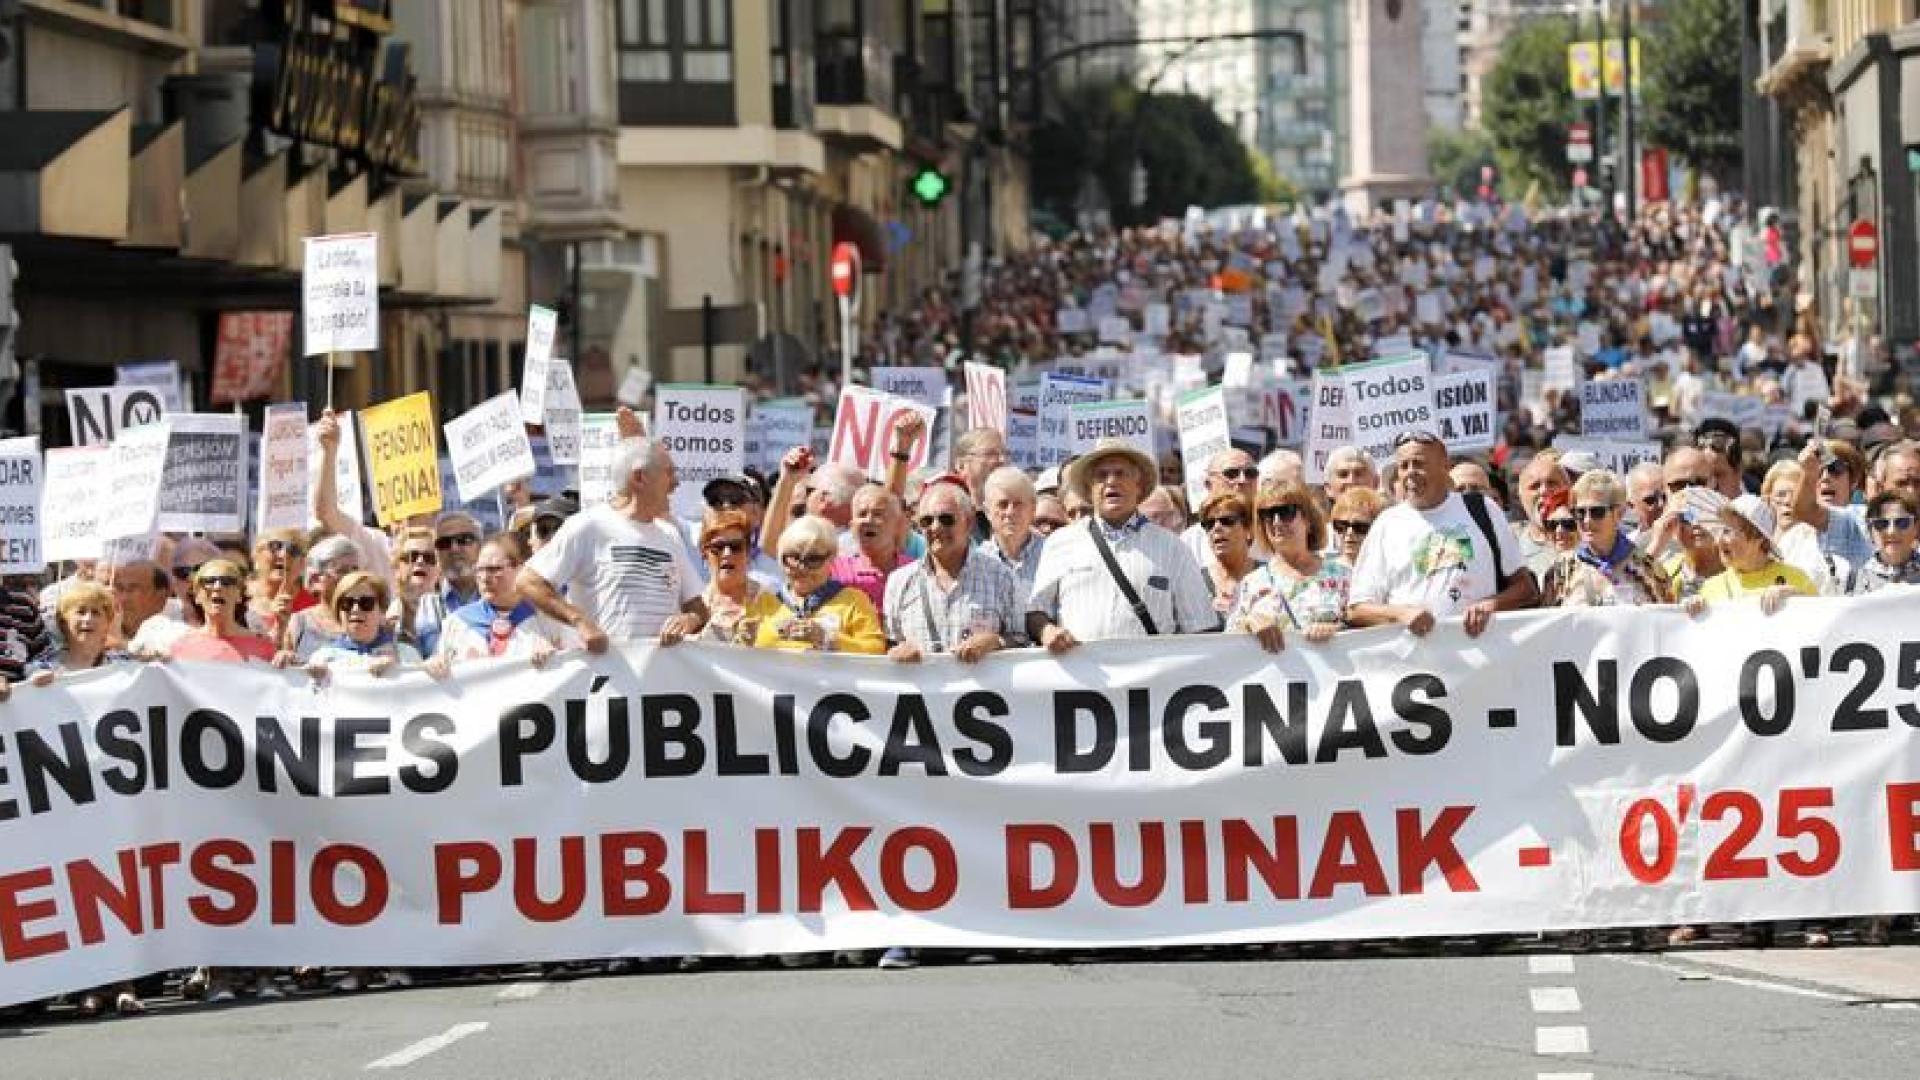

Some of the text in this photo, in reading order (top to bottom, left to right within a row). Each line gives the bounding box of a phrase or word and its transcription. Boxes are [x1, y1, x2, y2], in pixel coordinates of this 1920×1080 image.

[1352, 375, 1425, 401] Todos
[1437, 380, 1488, 410] SIÓN
[664, 401, 736, 423] Todos
[1358, 405, 1431, 431] somos
[1461, 410, 1490, 435] YA!
[831, 393, 928, 476] NO
[1077, 415, 1148, 440] DEFIENDO
[661, 436, 734, 453] somos
[499, 675, 1014, 787] PÚBLICAS
[1053, 674, 1453, 774] DIGNAS
[1488, 708, 1517, 728] -
[1553, 656, 1700, 747] NO
[0, 838, 390, 963] ENTSIO
[433, 826, 959, 925] PUBLIKO
[1005, 805, 1481, 910] DUINAK
[1518, 847, 1552, 868] -
[1619, 783, 1842, 885] 0'25
